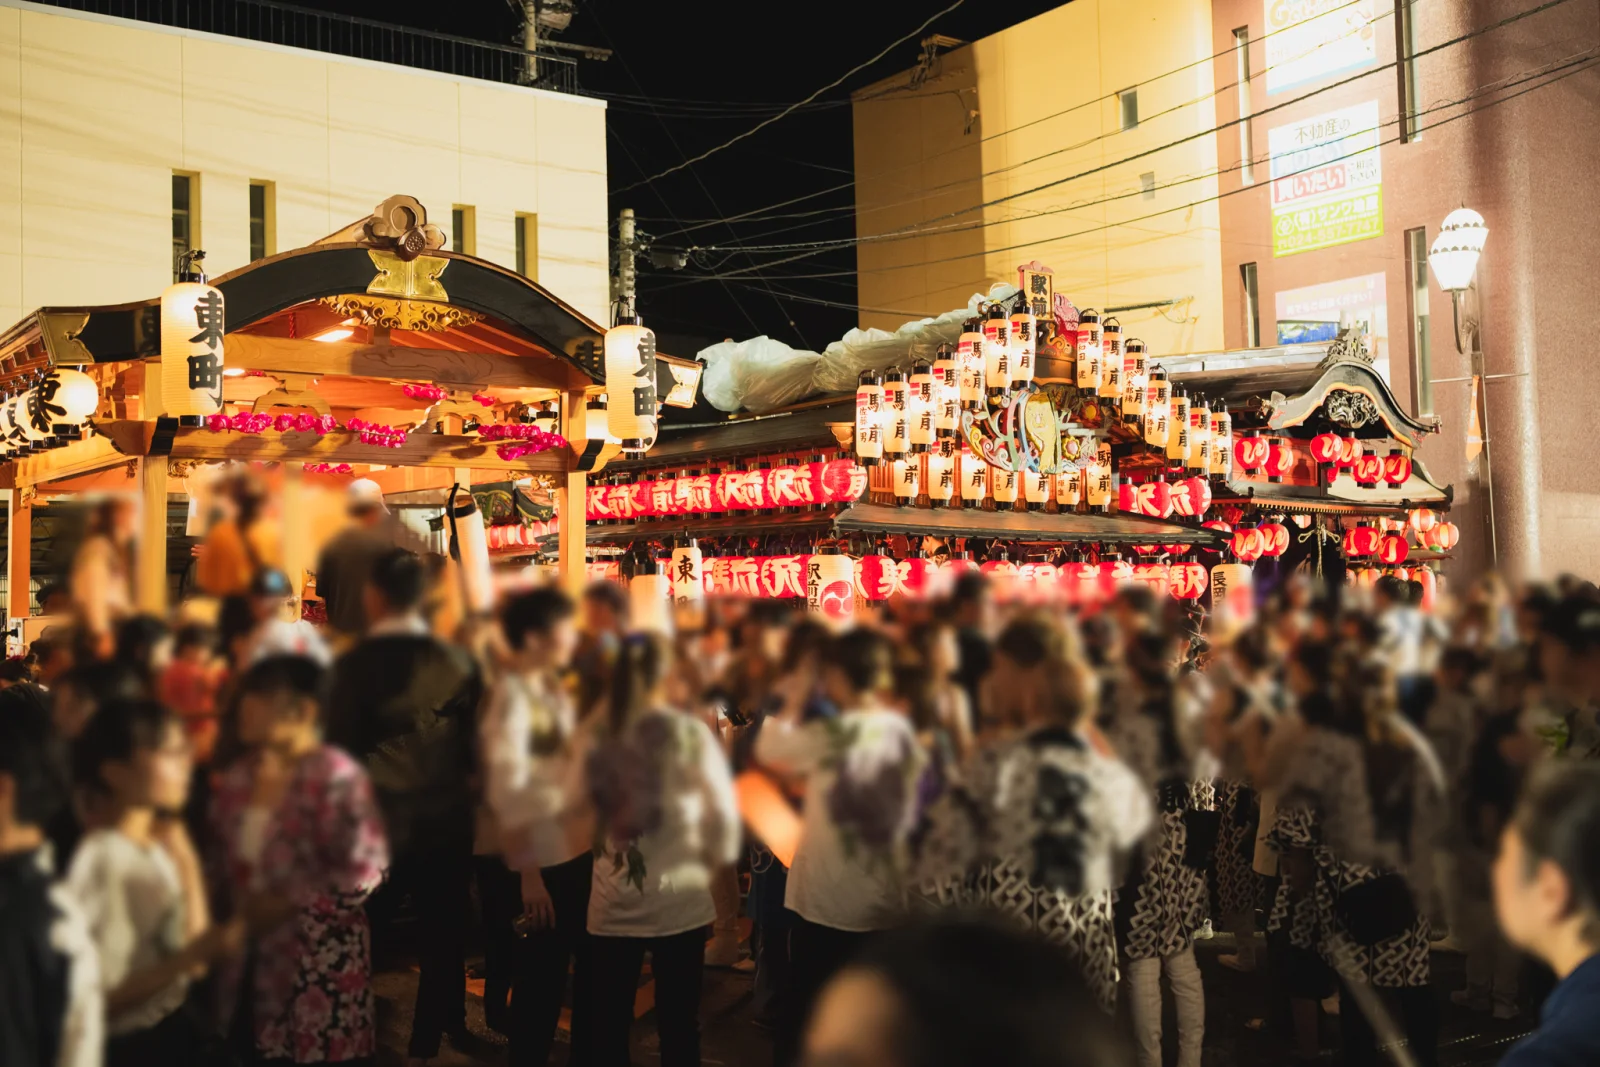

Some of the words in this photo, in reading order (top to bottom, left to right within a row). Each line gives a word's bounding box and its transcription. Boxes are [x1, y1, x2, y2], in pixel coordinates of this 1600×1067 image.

[1294, 117, 1351, 144] 不動産の
[1031, 273, 1048, 318] 駅前
[187, 289, 225, 408] 東町
[632, 331, 656, 432] 東町
[938, 440, 955, 490] 駅前
[1097, 450, 1111, 493] 駅前
[1167, 562, 1205, 597] 駅
[1213, 571, 1227, 607] 長岡
